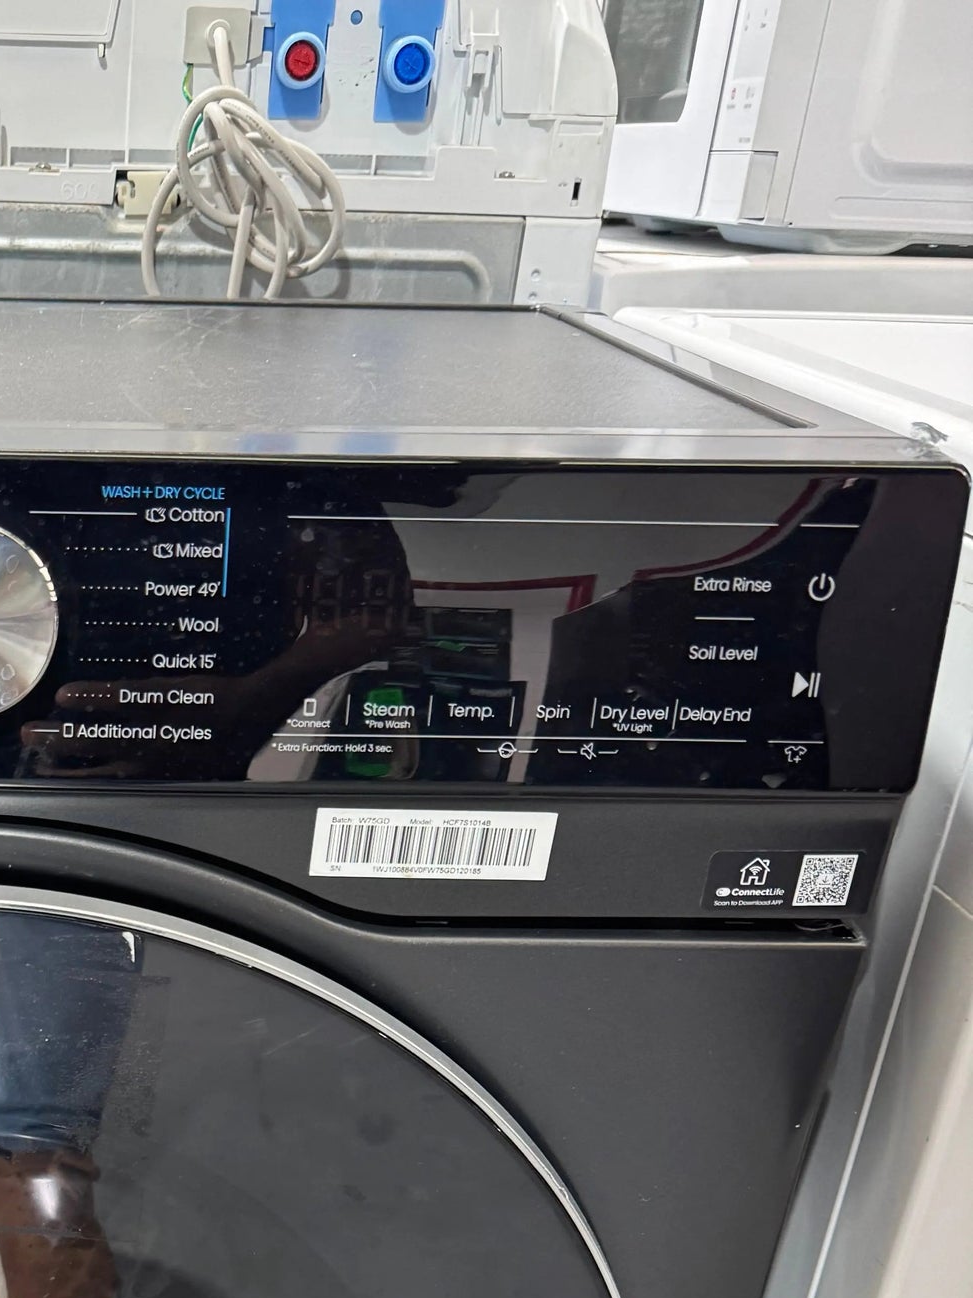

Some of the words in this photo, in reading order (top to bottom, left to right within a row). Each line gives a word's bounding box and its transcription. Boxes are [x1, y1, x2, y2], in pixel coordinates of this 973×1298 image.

[101, 485, 141, 499] WASH
[155, 487, 181, 499] DRY
[183, 487, 225, 500] CYCLE
[169, 507, 224, 522] Cotton
[176, 543, 223, 559] Mixed
[145, 582, 195, 597] Power
[694, 577, 729, 592] Extra
[732, 578, 771, 592] Rinse
[179, 617, 219, 632] Wool
[689, 646, 716, 660] Soil
[719, 646, 758, 660] Level
[153, 654, 195, 669] Quick
[119, 689, 163, 704] Drum
[167, 690, 215, 705] Clean
[362, 702, 415, 717] Steam
[448, 703, 495, 721] Temp.
[536, 705, 570, 722] Spin
[600, 705, 626, 723] Dry
[630, 706, 669, 720] Level
[679, 707, 721, 724] Delay
[723, 707, 752, 722] End
[385, 720, 411, 729] Wash
[630, 723, 653, 733] Light
[77, 724, 156, 739] Additional
[160, 725, 212, 743] Cycles
[278, 744, 300, 752] Extra
[302, 744, 344, 753] Function:
[345, 744, 366, 753] Hold
[368, 744, 373, 753] 3
[375, 745, 393, 753] sec.
[732, 888, 784, 897] ConnectLife
